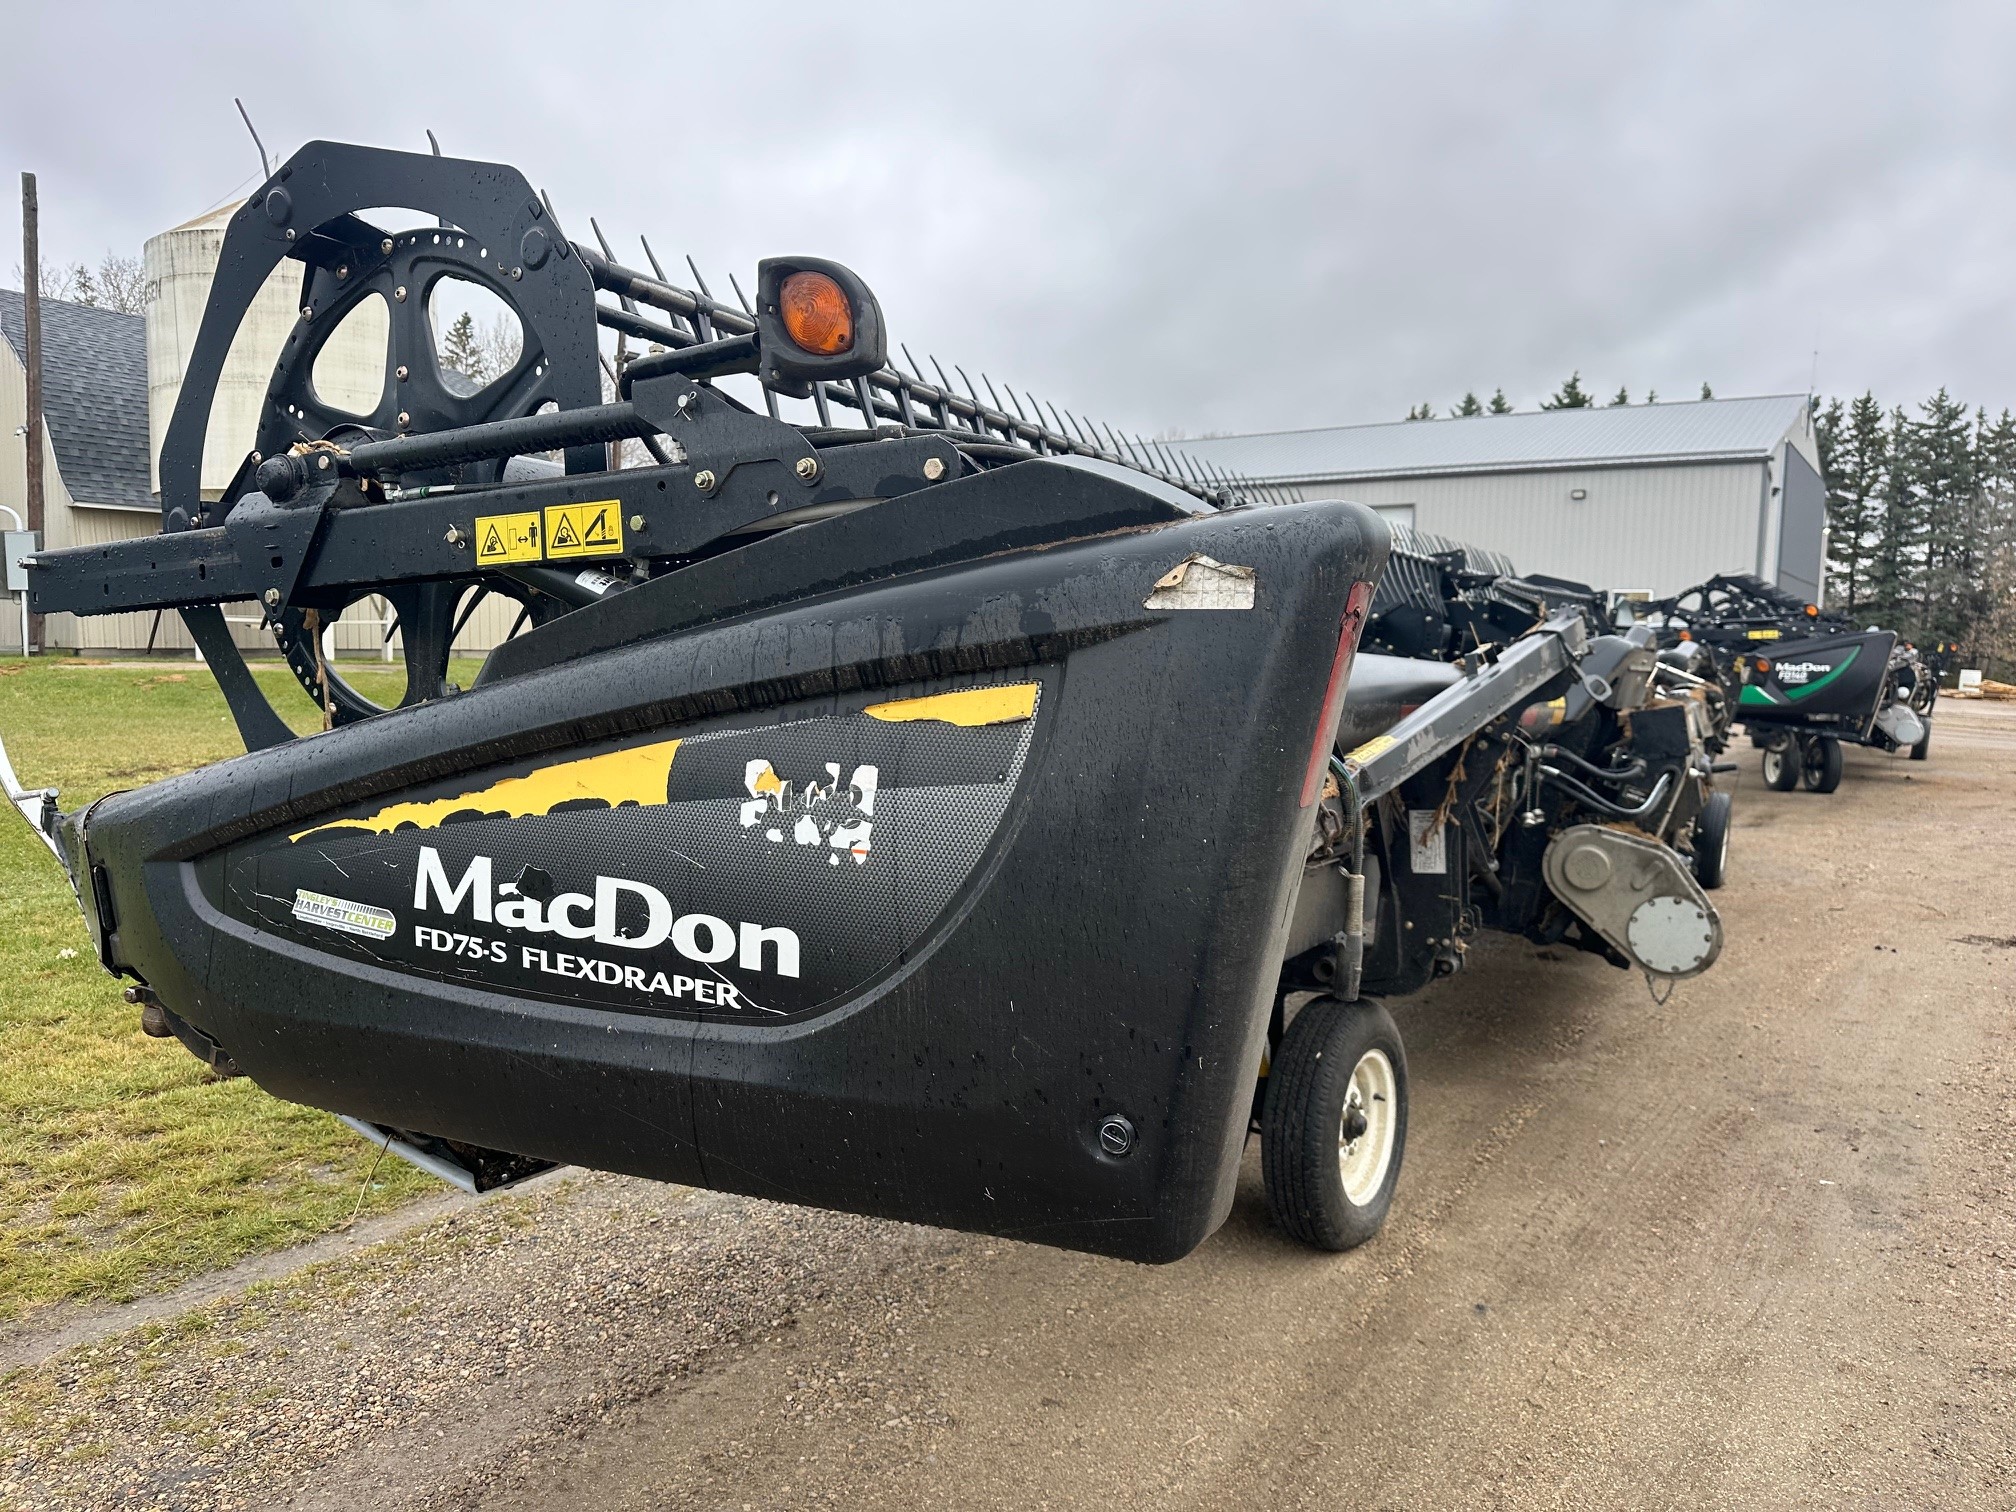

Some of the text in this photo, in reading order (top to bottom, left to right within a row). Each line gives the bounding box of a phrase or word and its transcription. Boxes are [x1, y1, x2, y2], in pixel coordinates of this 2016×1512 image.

[1775, 662, 1831, 672] MacDon
[298, 890, 339, 907] TINGLEY'S
[414, 845, 800, 979] MacDon
[415, 926, 742, 1009] FD75-S FLEXDRAPER
